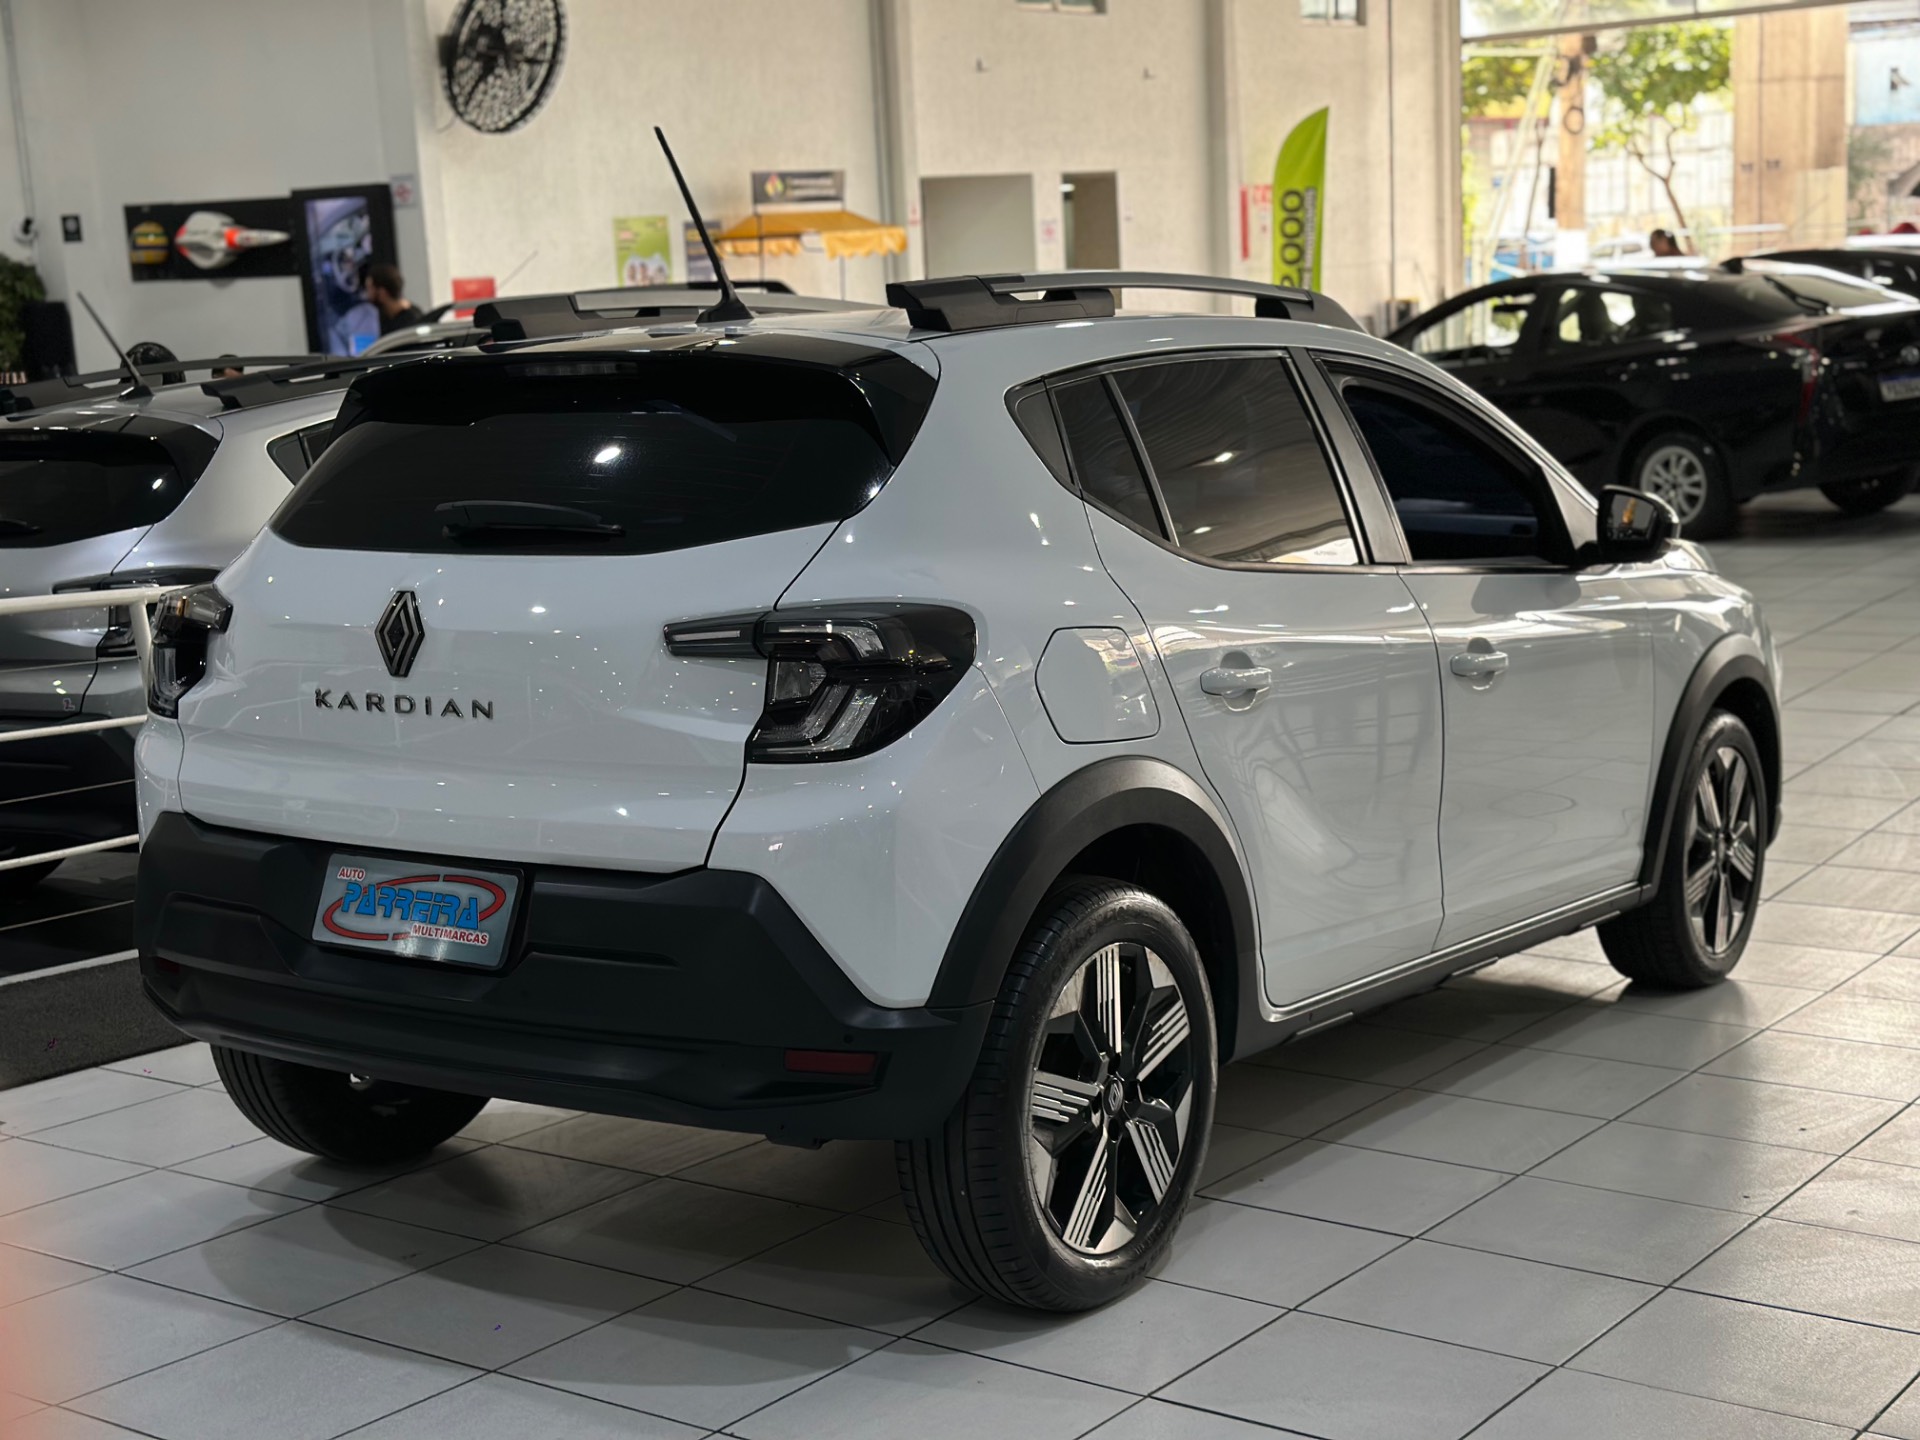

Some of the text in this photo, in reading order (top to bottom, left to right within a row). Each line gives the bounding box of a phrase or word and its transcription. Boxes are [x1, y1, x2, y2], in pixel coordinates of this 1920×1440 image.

[314, 688, 494, 720] KARDIAN
[338, 867, 365, 880] AUTO
[341, 882, 480, 930] PARREIRA
[412, 924, 489, 945] MULTIMARCAS
